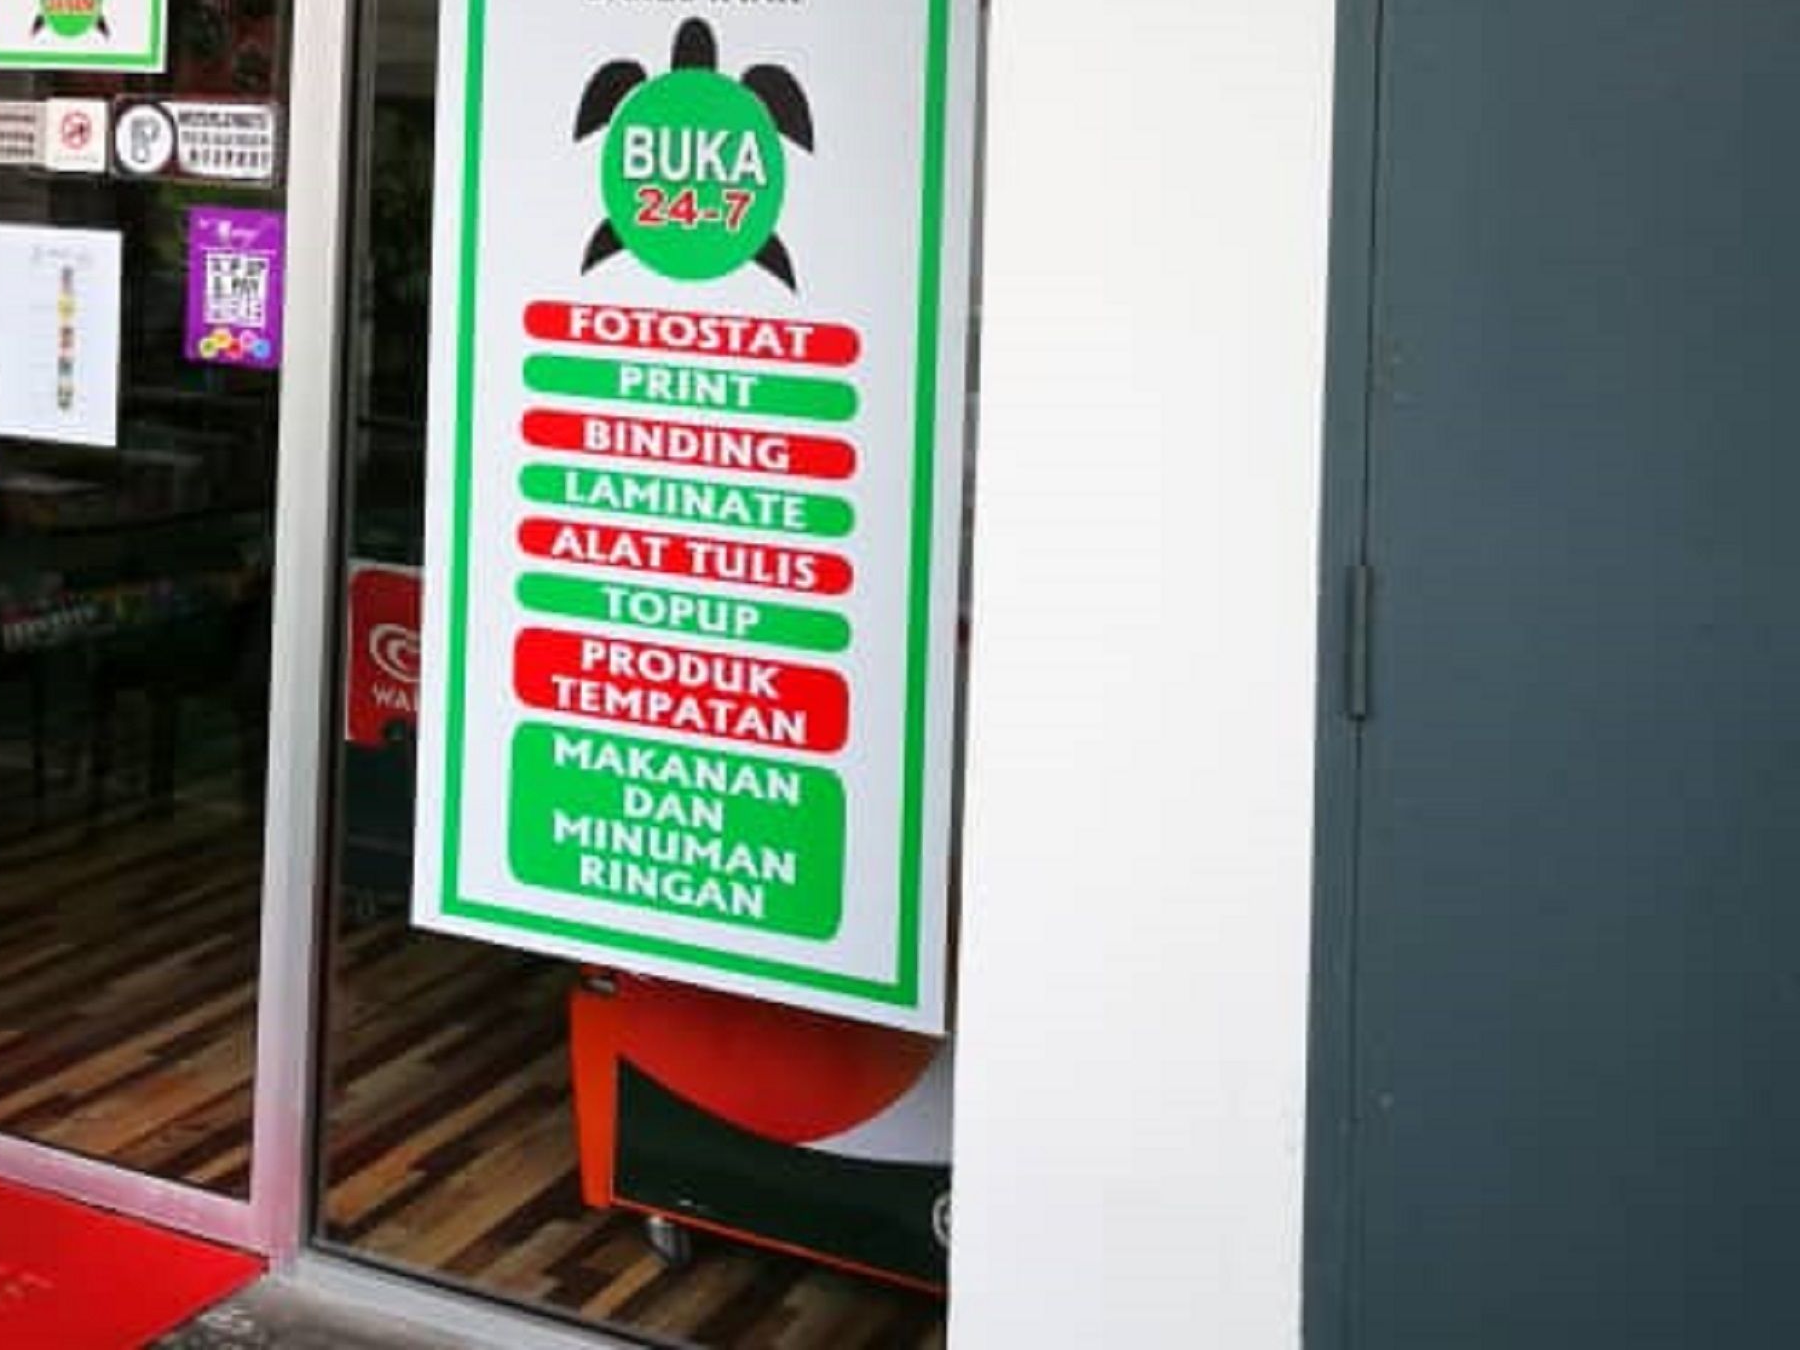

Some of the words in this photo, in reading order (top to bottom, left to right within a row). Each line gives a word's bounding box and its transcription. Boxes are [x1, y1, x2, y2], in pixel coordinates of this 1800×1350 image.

[623, 126, 766, 185] BUKA
[636, 189, 753, 230] 24-7
[568, 308, 814, 357] FOTOSTAT
[618, 364, 759, 408] PRINT
[584, 420, 792, 472] BINDING
[564, 472, 808, 530] LAMINATE
[551, 527, 665, 568] ALAT
[685, 542, 816, 590] TULIS
[600, 586, 761, 637] TOPUP
[580, 639, 781, 699] PRODUK
[551, 676, 808, 745] TEMPATAN
[553, 737, 800, 805] MAKANAN
[622, 787, 723, 830] DAN
[553, 813, 797, 884] MINUMAN
[579, 854, 764, 920] RINGAN
